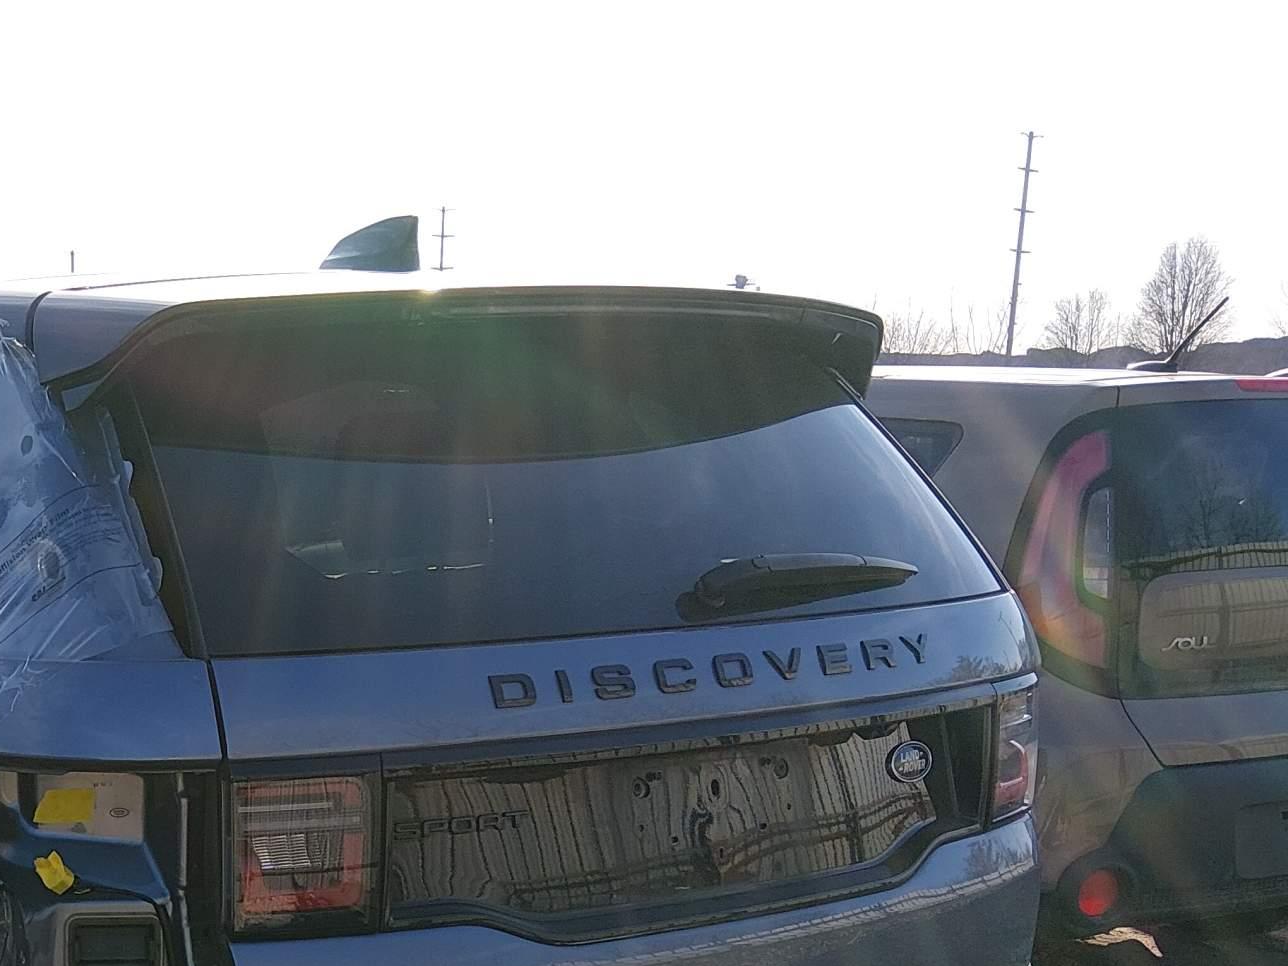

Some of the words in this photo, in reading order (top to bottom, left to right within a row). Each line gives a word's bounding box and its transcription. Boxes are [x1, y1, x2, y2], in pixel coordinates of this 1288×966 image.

[487, 632, 929, 710] DISCOVERY
[900, 749, 920, 763] LAND
[394, 809, 529, 842] SPORT
